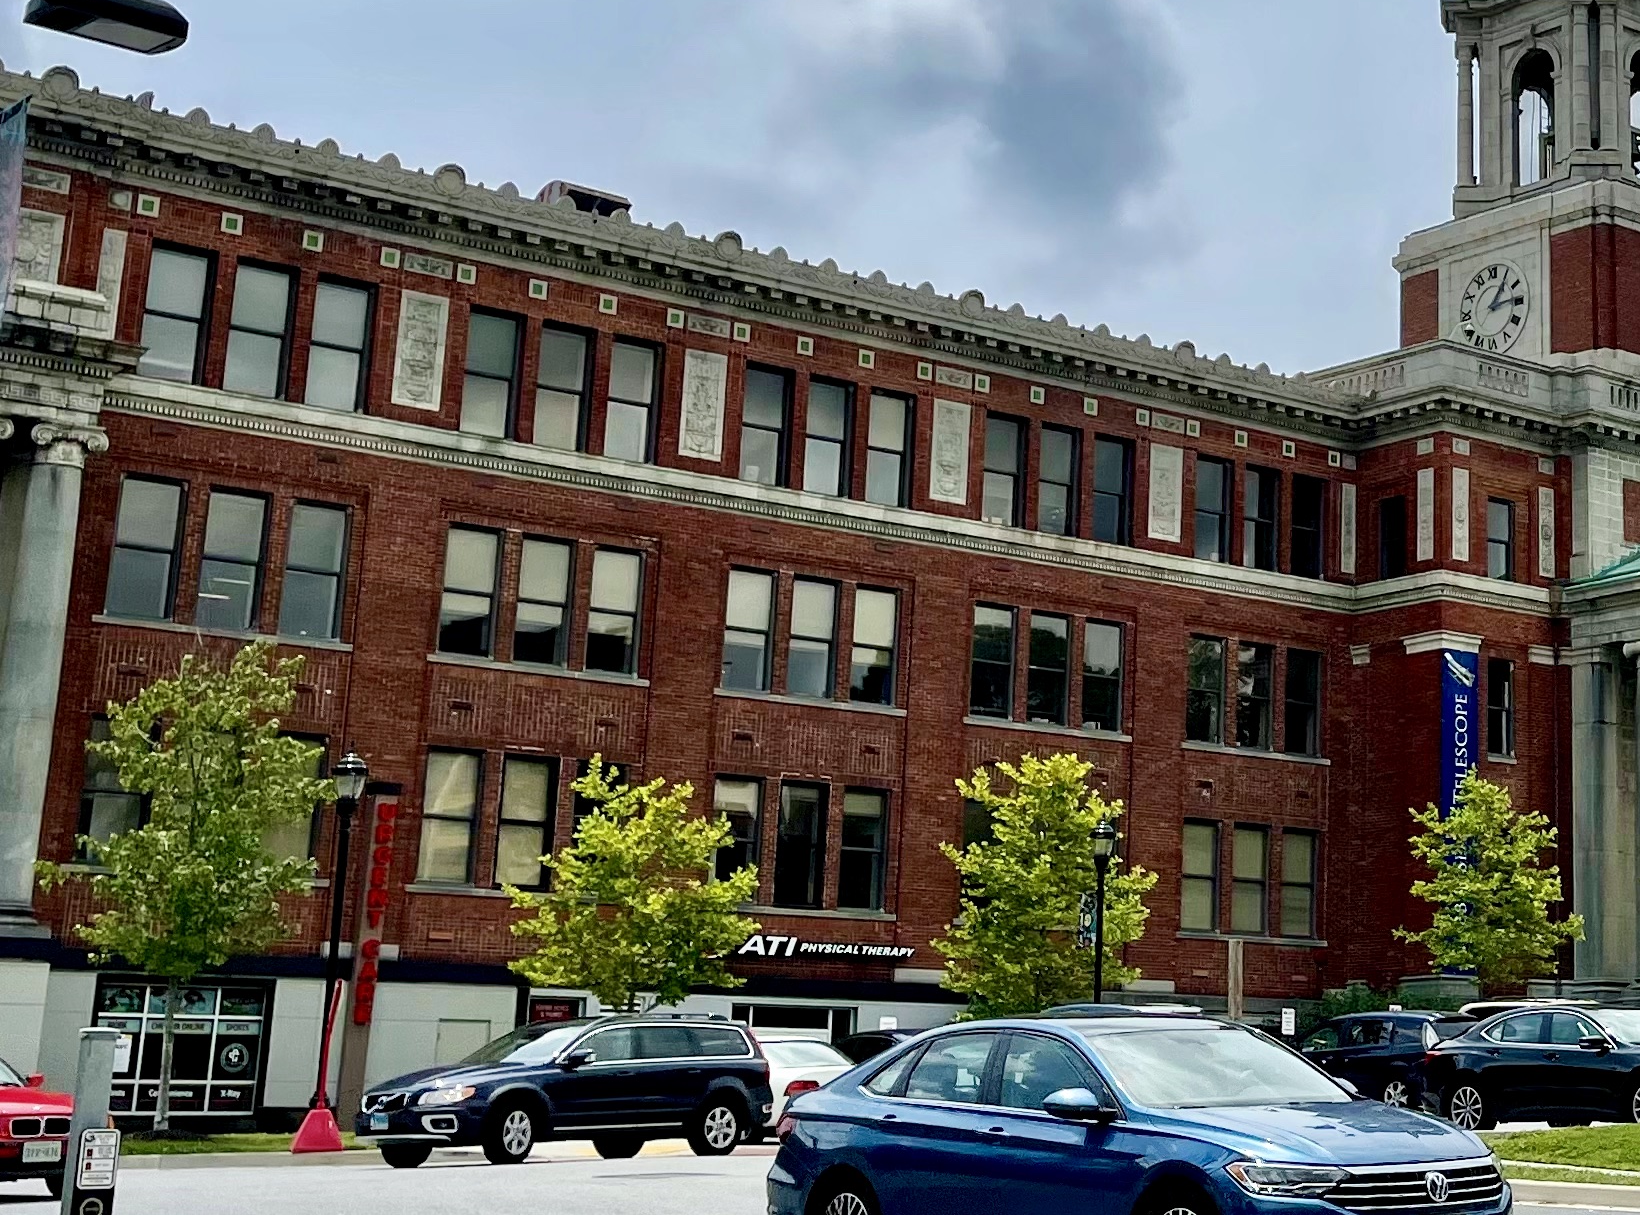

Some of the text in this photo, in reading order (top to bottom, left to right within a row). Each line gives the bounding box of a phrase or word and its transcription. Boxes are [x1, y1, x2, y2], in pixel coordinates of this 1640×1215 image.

[1453, 693, 1468, 805] TELESCOPE
[738, 935, 916, 958] ATI PHYSICAL THERAPY
